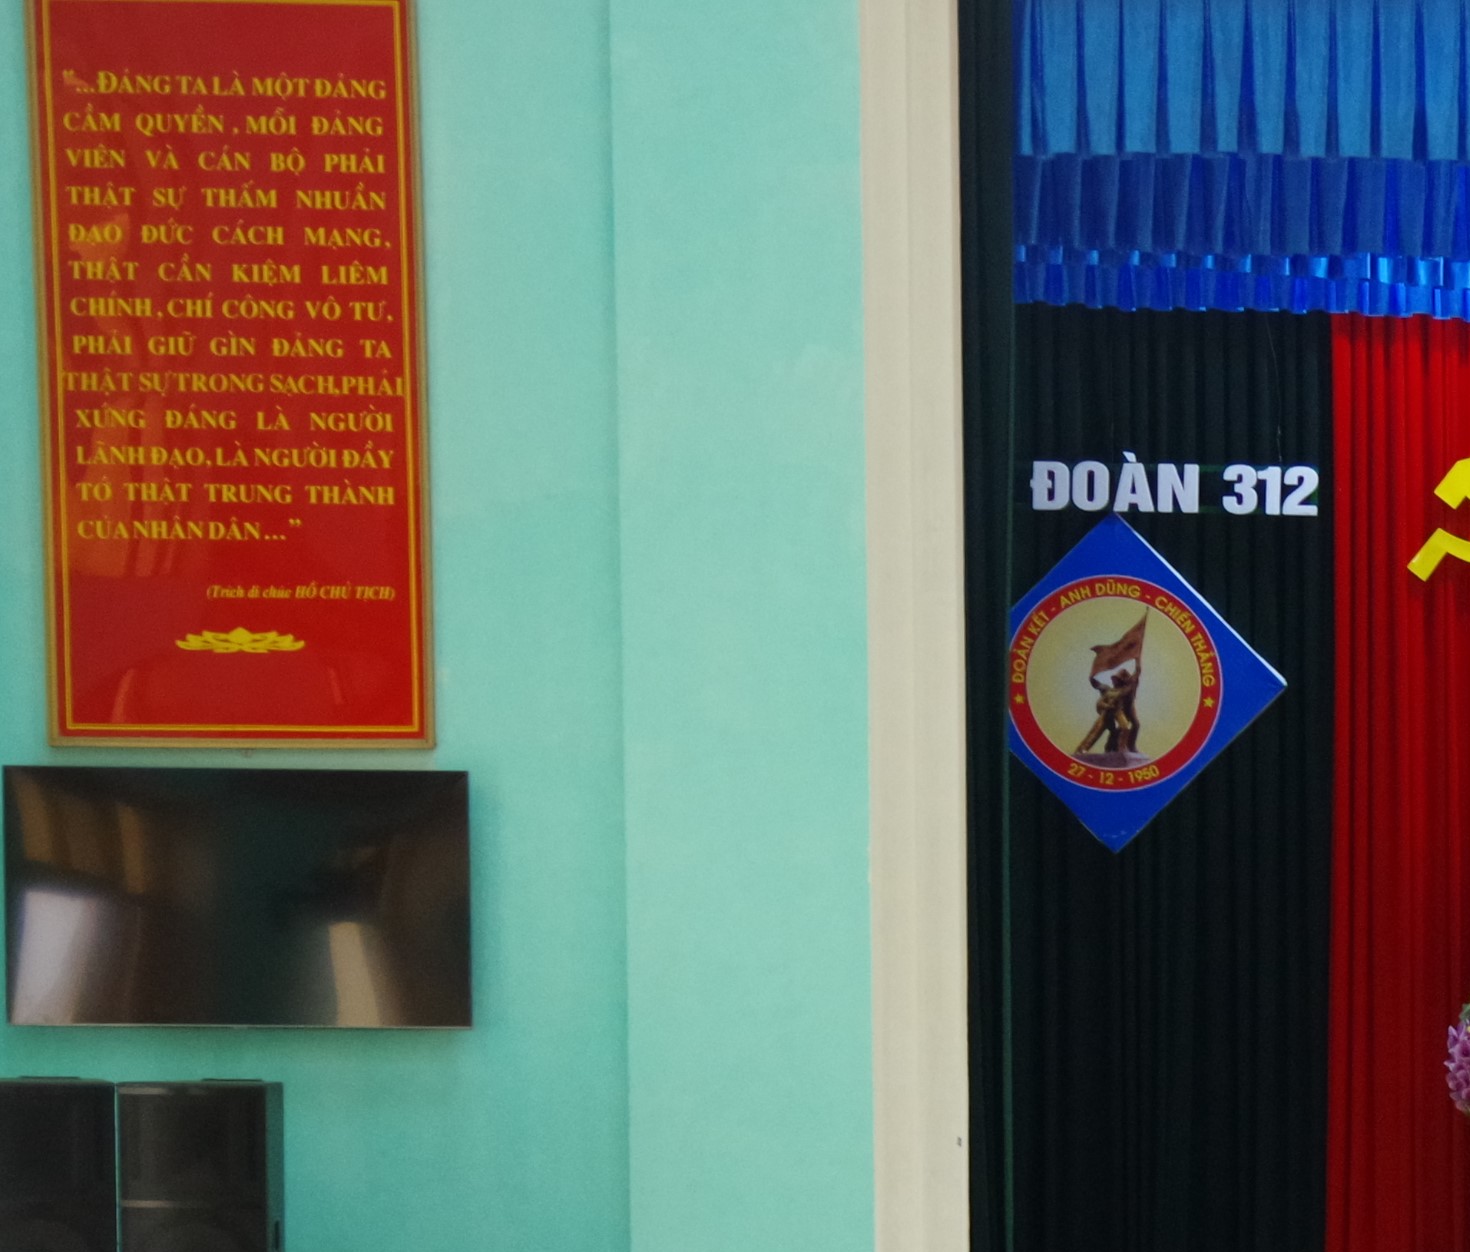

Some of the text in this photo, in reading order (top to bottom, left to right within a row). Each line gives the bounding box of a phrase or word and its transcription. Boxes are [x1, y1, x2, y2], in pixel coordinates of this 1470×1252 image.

[176, 74, 208, 95] TA
[212, 71, 245, 96] LÀ
[252, 72, 310, 101] MỘT
[315, 72, 386, 99] ĐẢNG
[66, 143, 385, 176] VIÊN VÀ CÁN BỘ PHẢI
[65, 180, 385, 210] THẬT SỰ THẤM NHUẦN
[68, 218, 391, 250] ĐẠO ĐỨC CÁCH MẠNG,
[68, 253, 388, 286] THẬT CẦN KIỆM LIÊM
[167, 292, 213, 318] CHÍ
[222, 294, 295, 320] CÔNG
[304, 296, 341, 320] VÔ
[73, 329, 392, 359] PHẢI GIỮ GÌN ĐẢNG TA
[75, 402, 394, 433] XỨNG ĐÁNG LÀ NGƯỜI
[1030, 451, 1319, 516] ĐOÀN 312
[1012, 580, 1215, 687] ĐOÀN KẾT ANH DŨNG CHIẾN THẮNG
[1068, 764, 1160, 785] 27 12 1950
